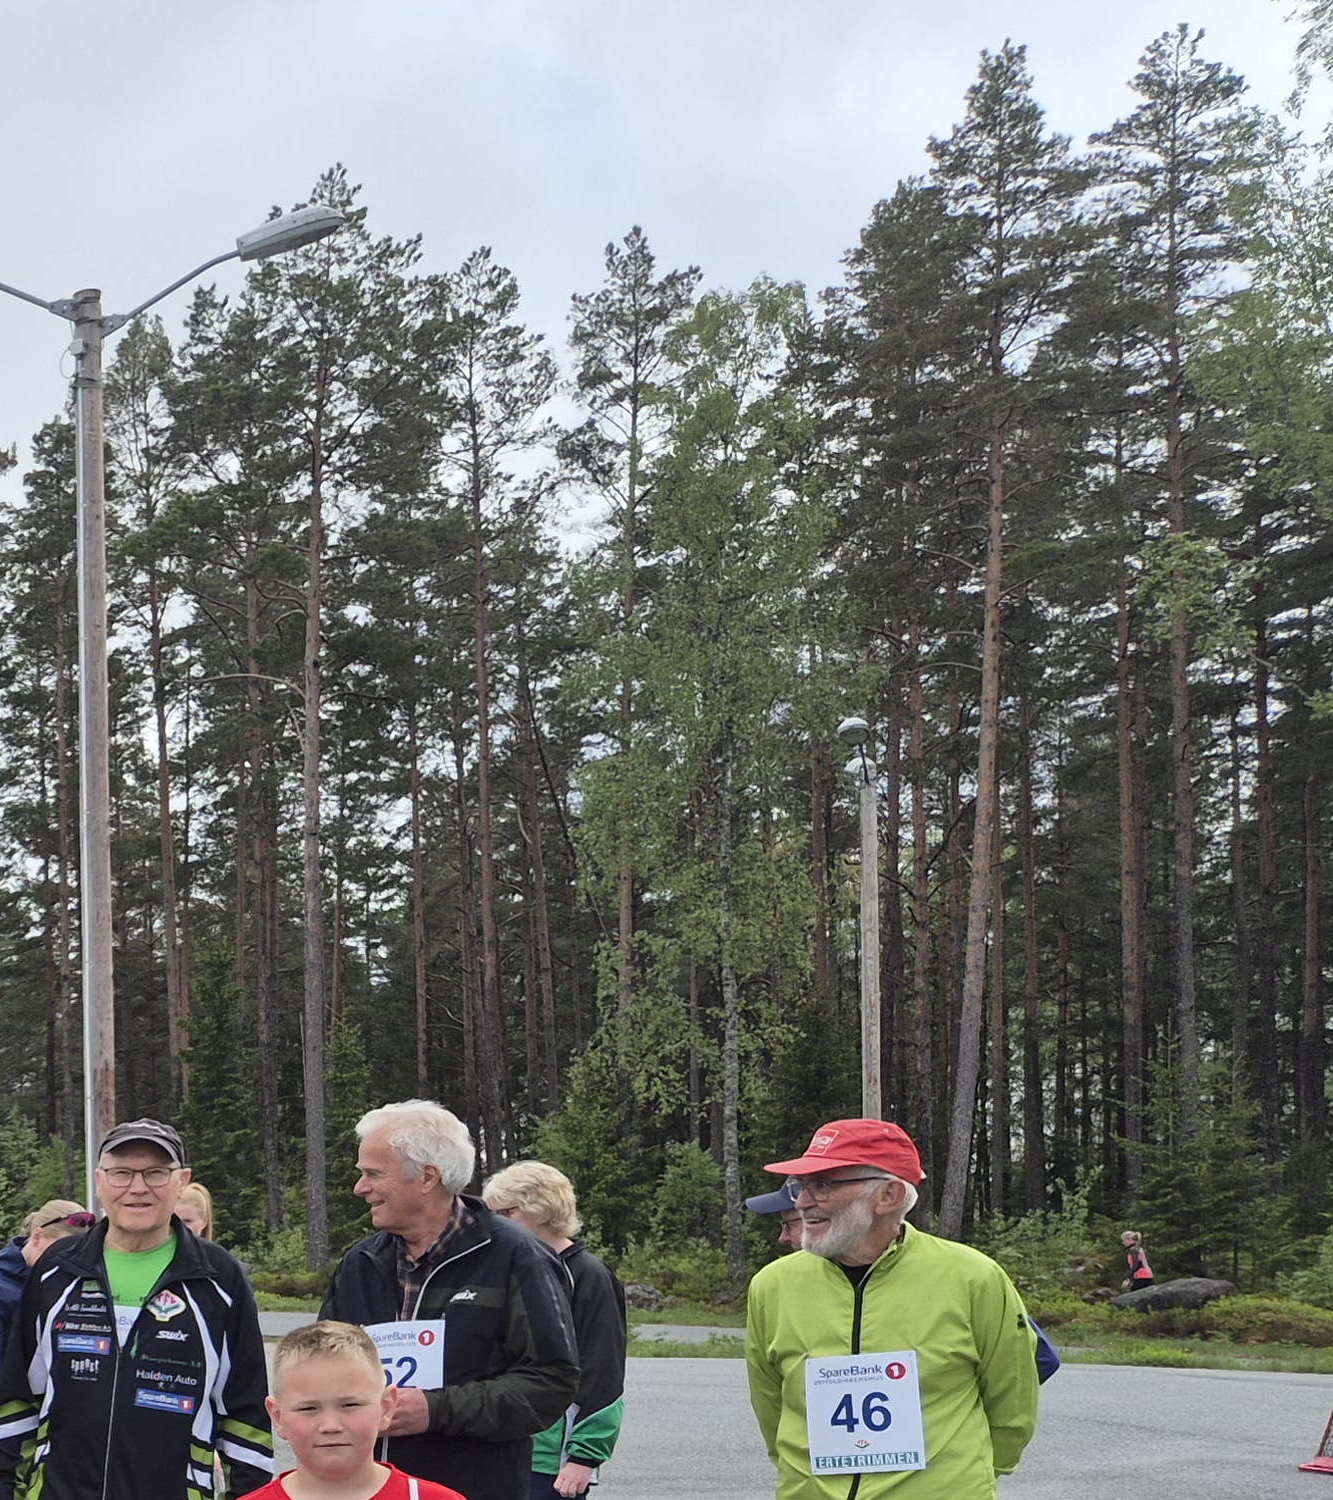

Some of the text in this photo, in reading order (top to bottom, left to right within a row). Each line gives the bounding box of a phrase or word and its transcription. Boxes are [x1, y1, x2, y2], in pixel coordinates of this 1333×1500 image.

[136, 1369, 197, 1386] Halden Auto
[819, 1364, 882, 1379] SpareBank
[830, 1392, 891, 1433] 46
[819, 1452, 914, 1468] ERTETRIMMEN
